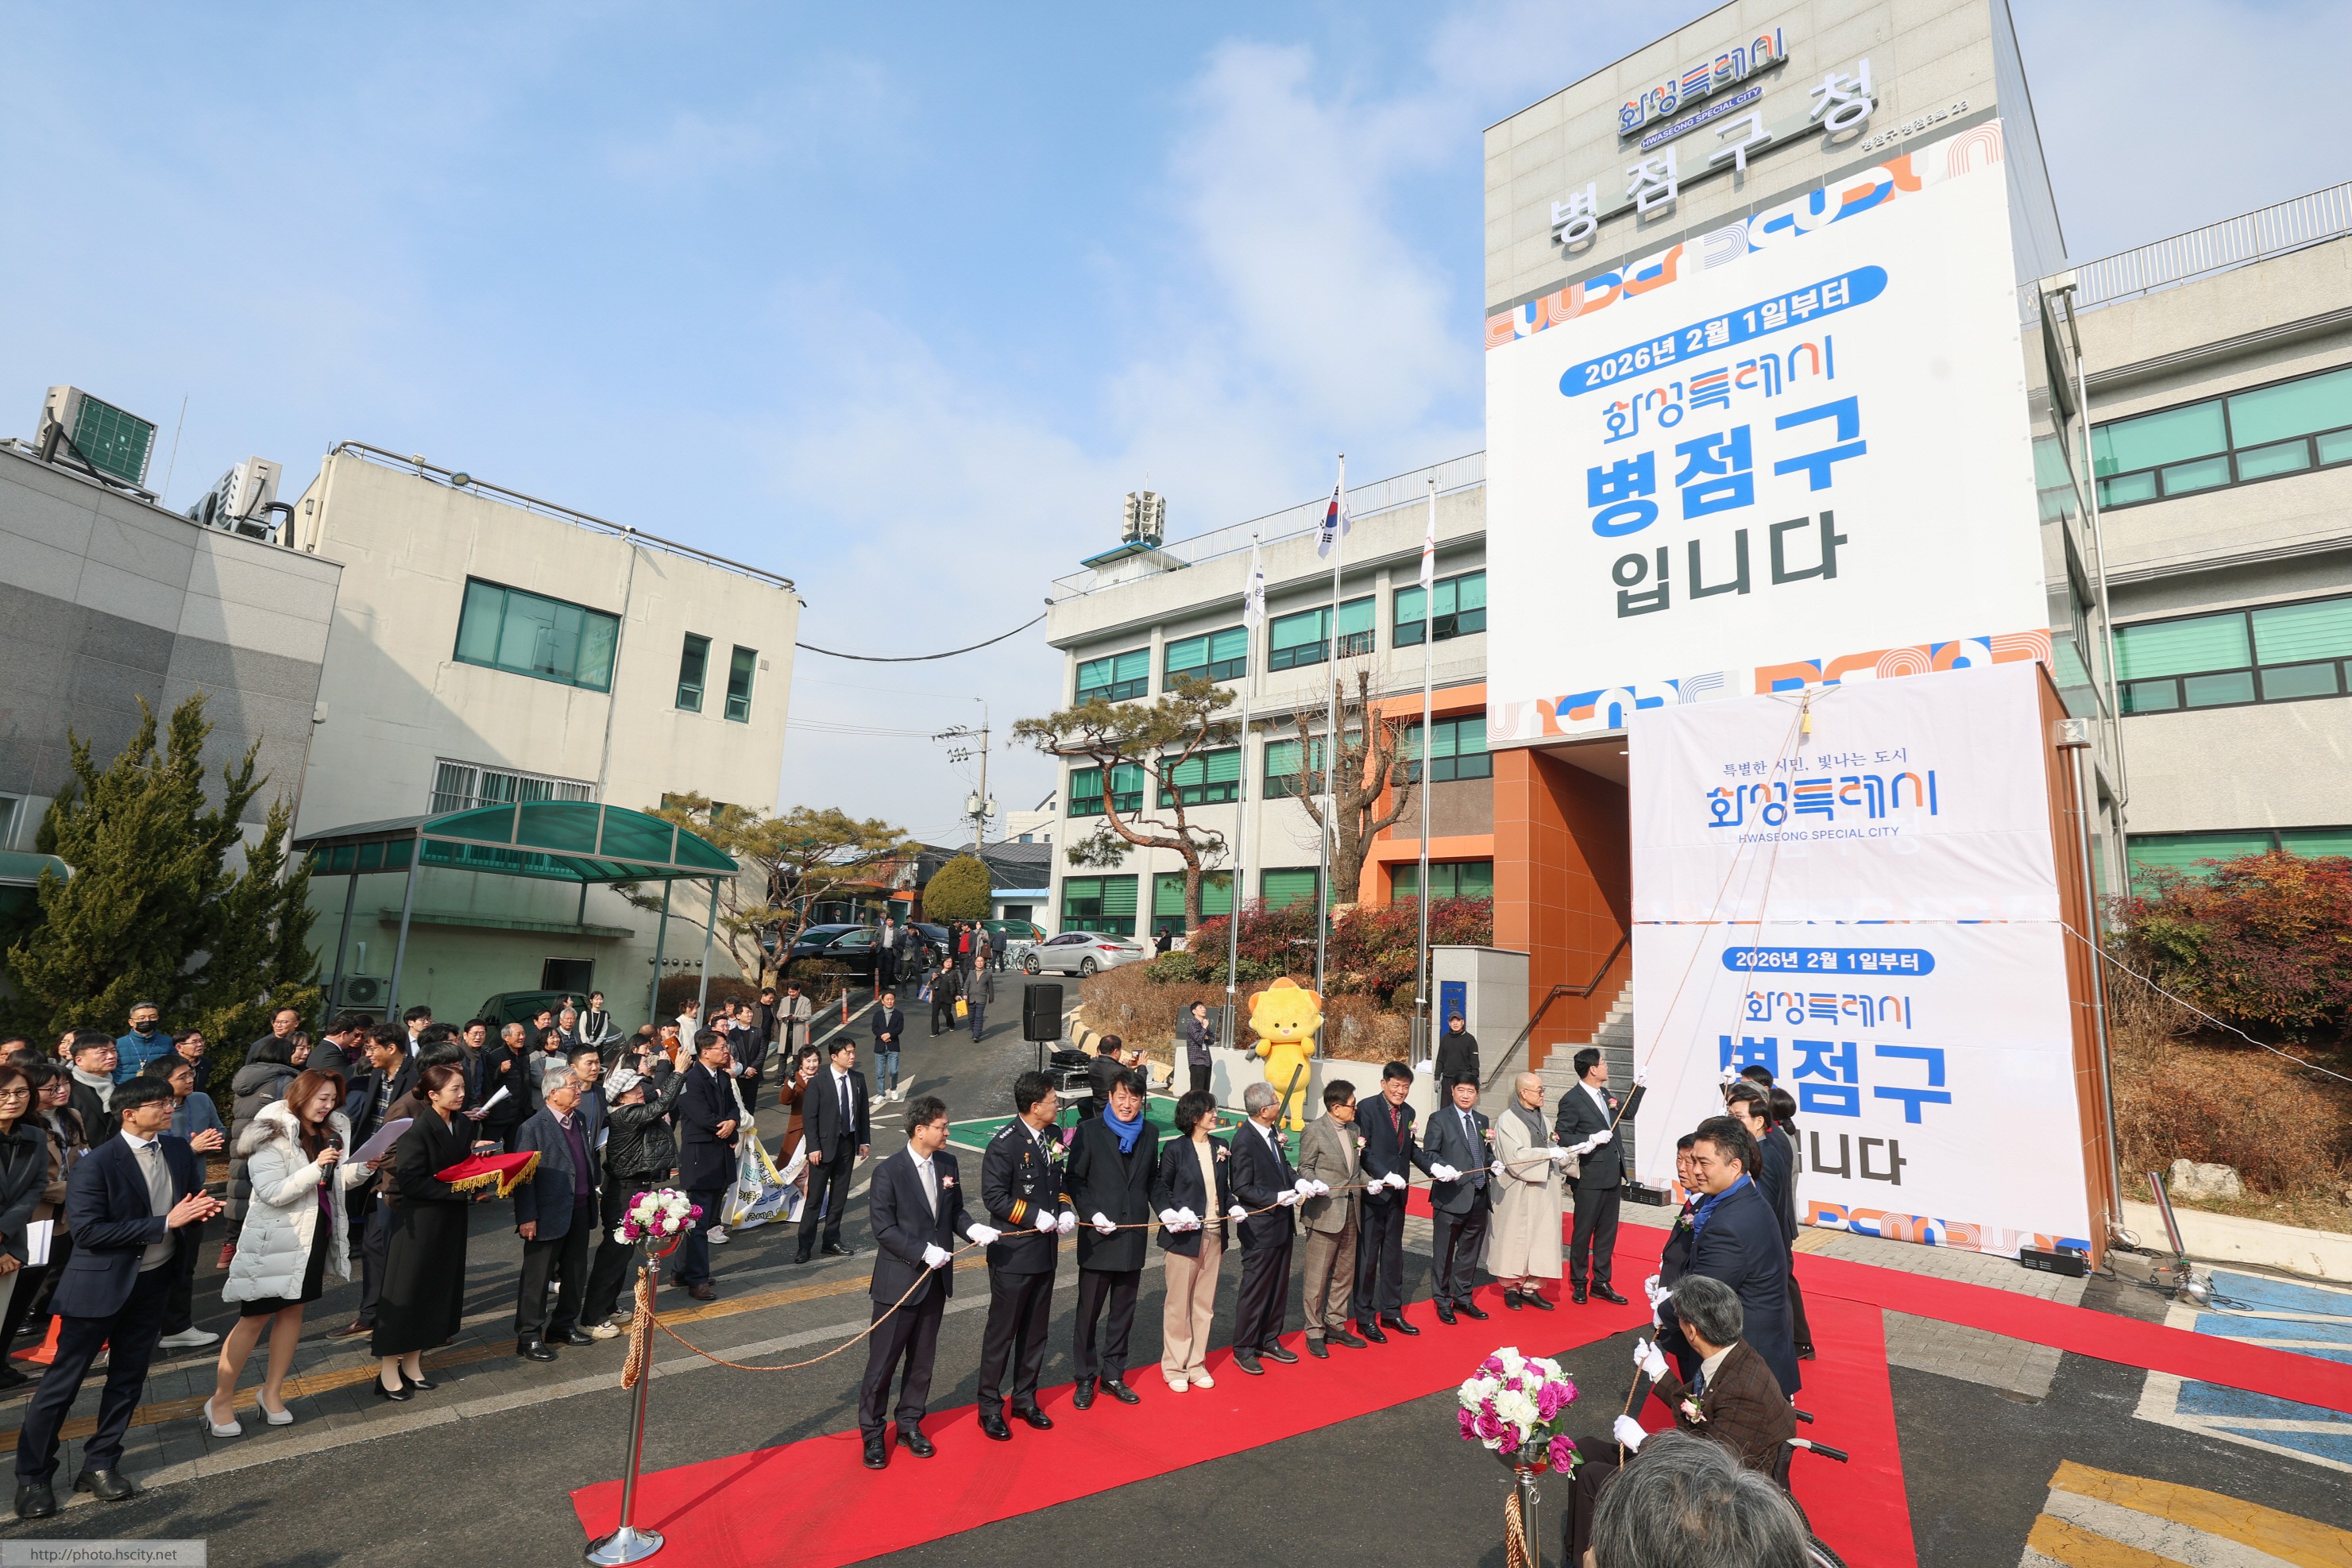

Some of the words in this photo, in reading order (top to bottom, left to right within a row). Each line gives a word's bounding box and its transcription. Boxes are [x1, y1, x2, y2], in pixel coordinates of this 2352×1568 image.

[1619, 27, 1783, 133] 화성특례시
[1952, 100, 1969, 116] 23
[1643, 118, 1694, 147] HWASEONG
[1695, 102, 1735, 122] SPECIAL
[1736, 87, 1760, 104] CITY
[1585, 335, 1676, 386] 2026년
[1686, 318, 1730, 352] 2월
[1743, 276, 1850, 334] 1일부터
[1602, 334, 1834, 445] 화성특례시
[1586, 395, 1867, 538] 병점구
[1612, 510, 1848, 618] 입니다
[1723, 760, 1767, 777] 특별한
[1817, 752, 1867, 770] 빛나는
[1875, 747, 1908, 763] 도시
[1706, 770, 1938, 828] 화성특례시
[1739, 831, 1808, 844] HWASEONG
[1812, 828, 1863, 840] SPECIAL
[1868, 826, 1900, 837] CITY
[1736, 951, 1798, 968] 2026년
[1806, 951, 1838, 970] 2월
[1847, 952, 1919, 971] 1일부터
[1745, 991, 1911, 1029] 화성특례시
[1794, 1129, 1907, 1186] 니다
